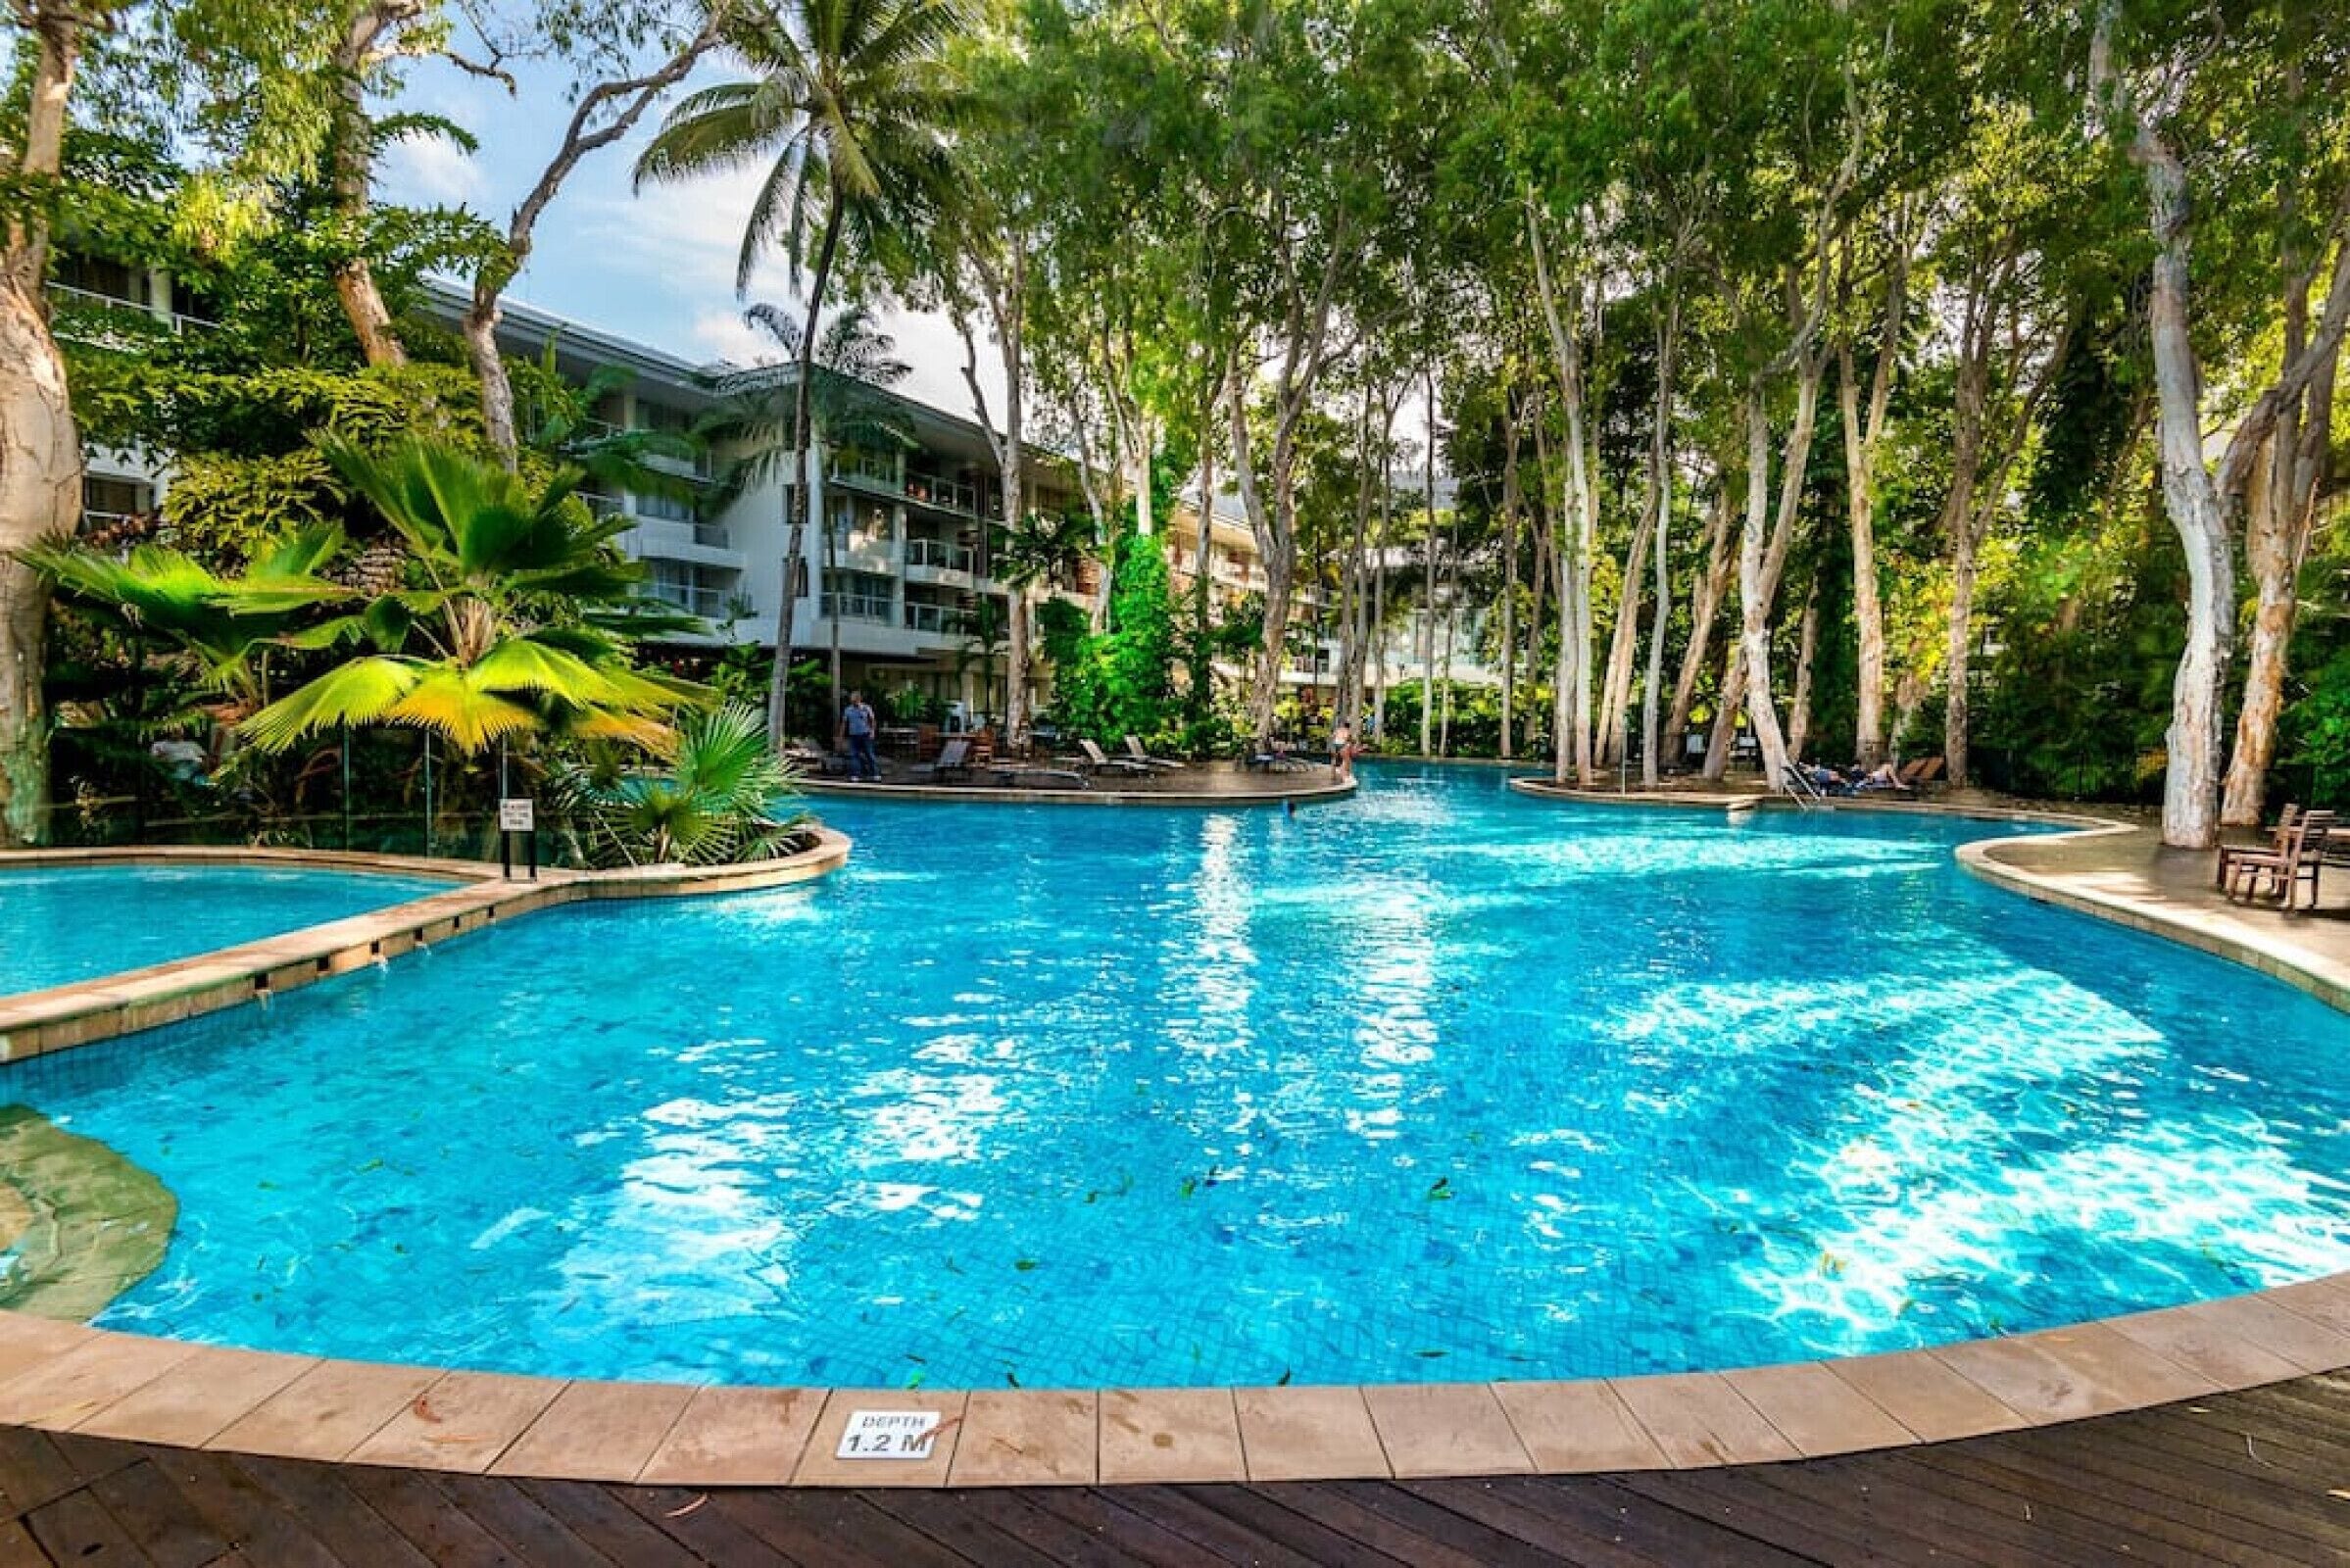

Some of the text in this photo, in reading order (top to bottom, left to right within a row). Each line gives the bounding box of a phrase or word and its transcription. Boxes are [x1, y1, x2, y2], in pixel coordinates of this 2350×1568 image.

[862, 1415, 926, 1428] DEPTH
[848, 1434, 929, 1451] 1.2 M
